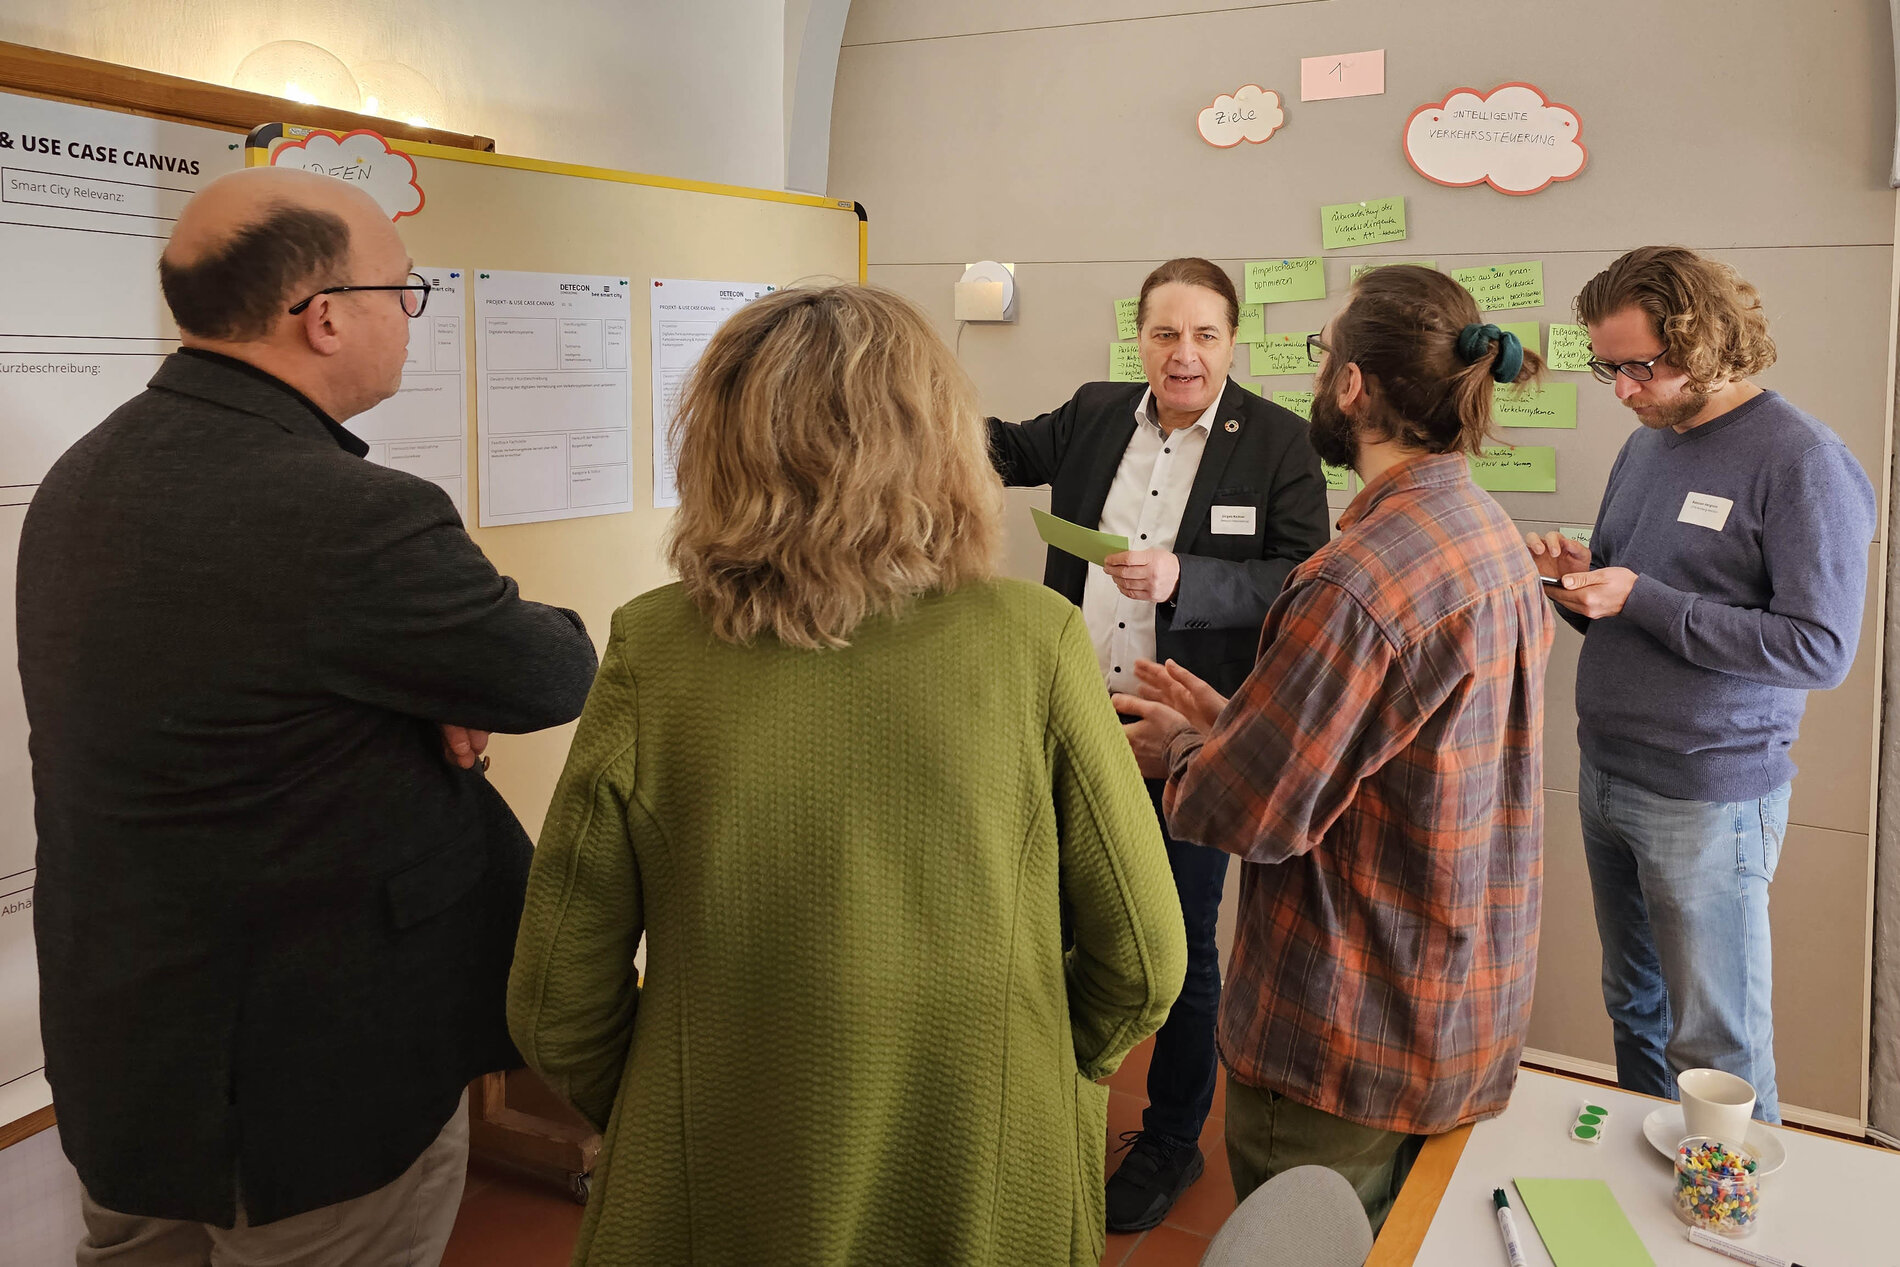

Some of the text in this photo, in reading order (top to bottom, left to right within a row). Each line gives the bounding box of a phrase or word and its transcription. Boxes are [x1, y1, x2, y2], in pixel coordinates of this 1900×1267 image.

[1329, 62, 1342, 82] 1
[1215, 107, 1257, 125] Ziele
[1429, 129, 1556, 147] VERKEHRSSTEUERUNG
[0, 132, 200, 176] & USE CASE CANVAS
[11, 179, 125, 202] Smart City Relevanz:
[560, 283, 590, 292] DETECON
[719, 290, 744, 298] DETECON
